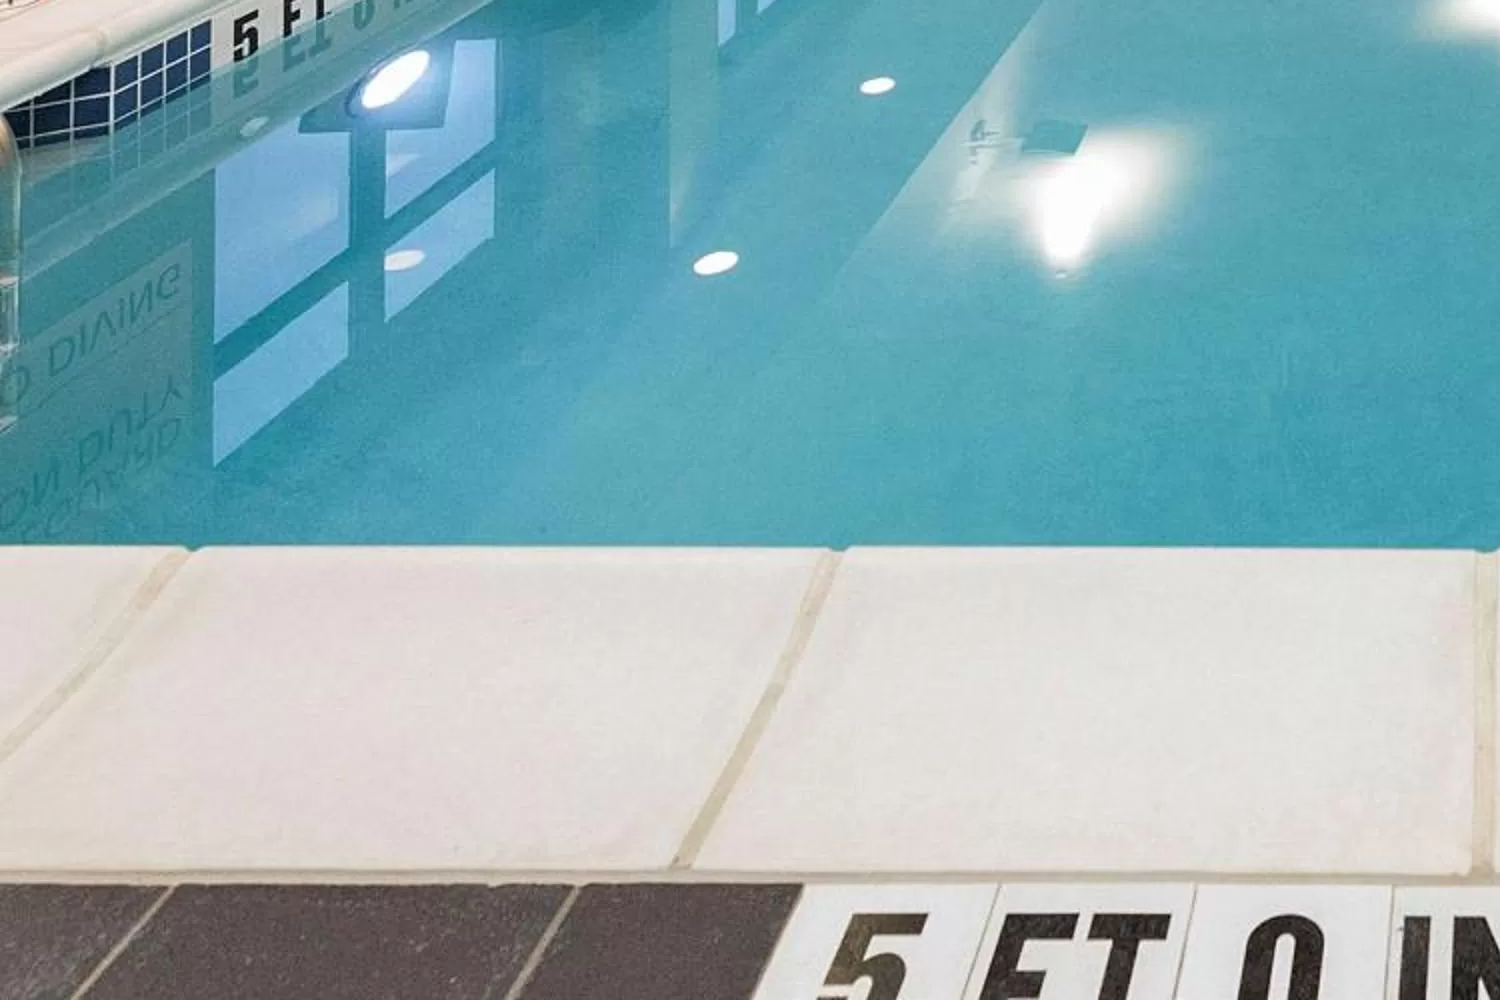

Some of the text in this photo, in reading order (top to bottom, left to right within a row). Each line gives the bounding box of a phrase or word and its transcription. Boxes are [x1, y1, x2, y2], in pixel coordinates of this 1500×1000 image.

[234, 8, 259, 63] 5
[824, 912, 930, 1000] 5
[979, 912, 1172, 1000] FT
